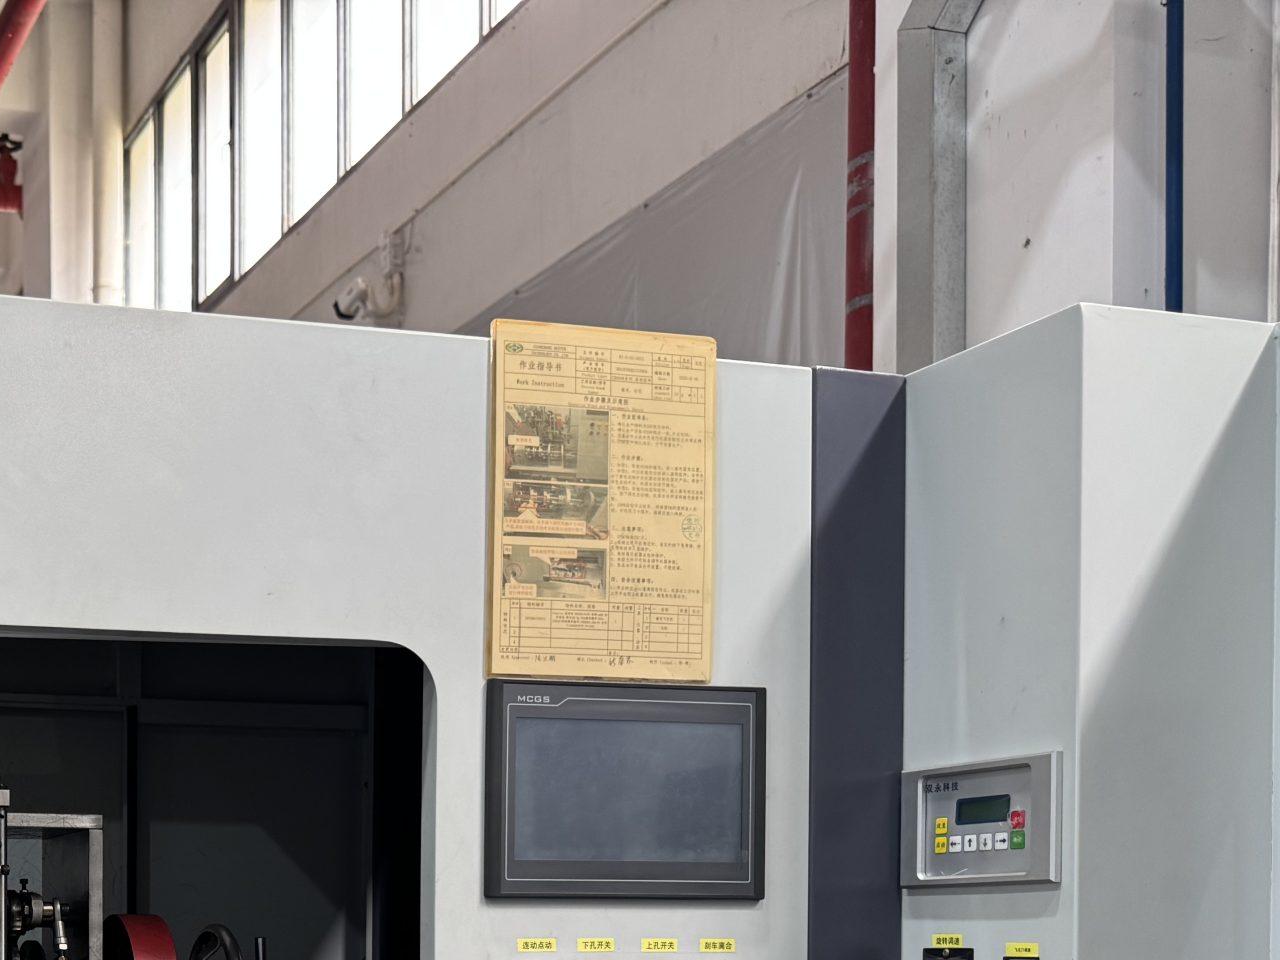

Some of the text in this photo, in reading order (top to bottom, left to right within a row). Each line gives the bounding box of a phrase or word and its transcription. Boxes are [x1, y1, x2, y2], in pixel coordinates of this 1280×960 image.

[517, 695, 550, 703] MCGS
[646, 941, 675, 950] 上孔开关
